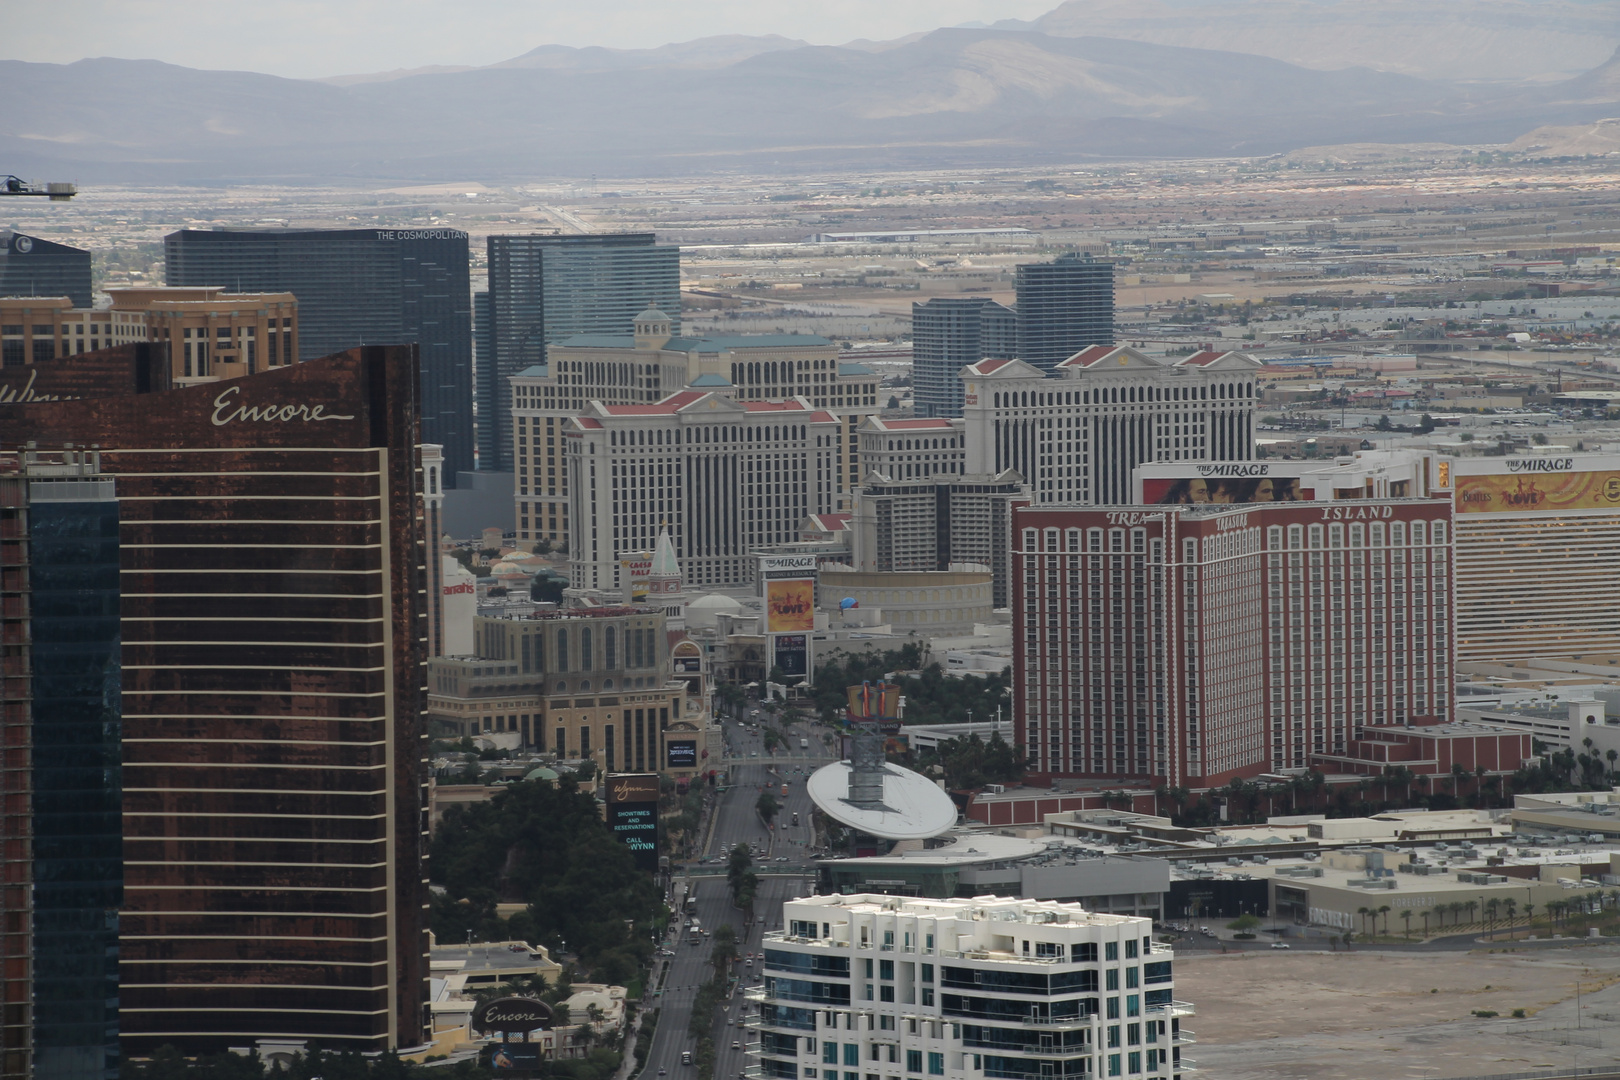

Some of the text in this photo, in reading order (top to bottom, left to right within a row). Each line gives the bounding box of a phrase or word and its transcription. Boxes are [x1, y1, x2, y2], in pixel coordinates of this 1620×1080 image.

[377, 230, 468, 240] THE COSMOPOLITAN
[211, 386, 355, 426] Encore
[1202, 465, 1269, 477] MIRAGE
[1510, 459, 1573, 472] MIRAGE
[1508, 493, 1537, 504] LOVE
[1107, 511, 1161, 526] TREA
[1321, 505, 1392, 520] ISLAND
[1216, 514, 1248, 531] TREASURE
[768, 558, 813, 568] MIRAGE
[777, 604, 803, 614] LOVE
[628, 842, 655, 851] -WYNN
[485, 1006, 548, 1023] Encore
